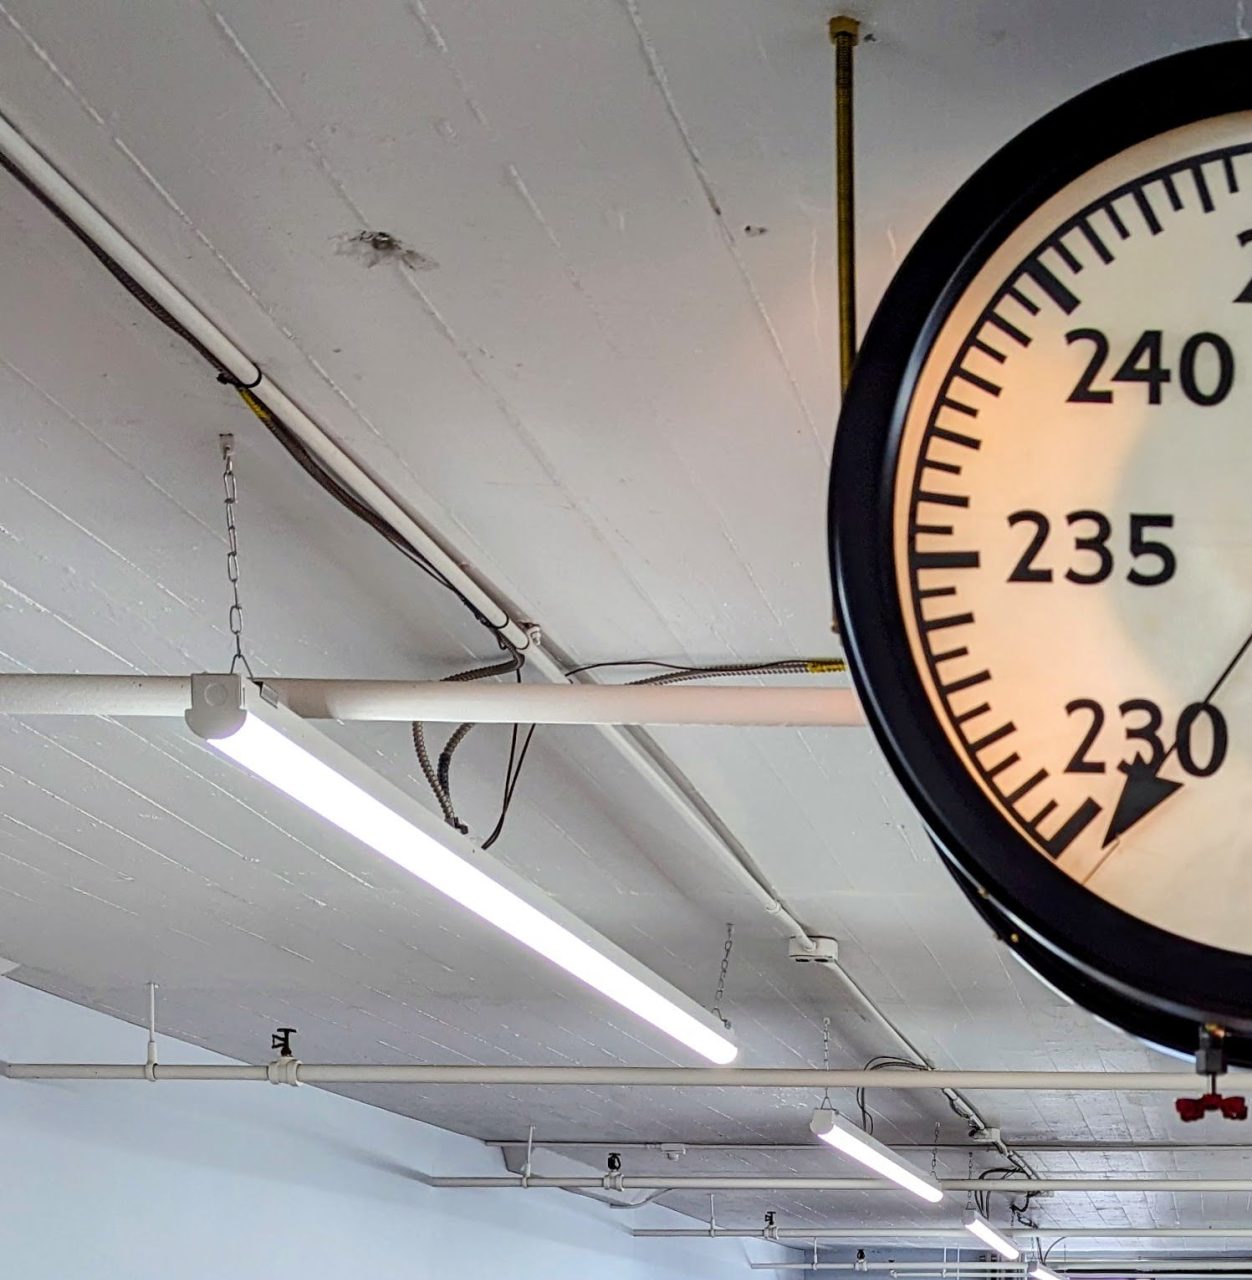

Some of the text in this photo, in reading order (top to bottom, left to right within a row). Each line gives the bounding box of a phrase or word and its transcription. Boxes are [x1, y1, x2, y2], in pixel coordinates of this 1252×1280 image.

[1063, 328, 1236, 406] 240
[1005, 510, 1177, 586] 235
[1063, 698, 1229, 778] 230
